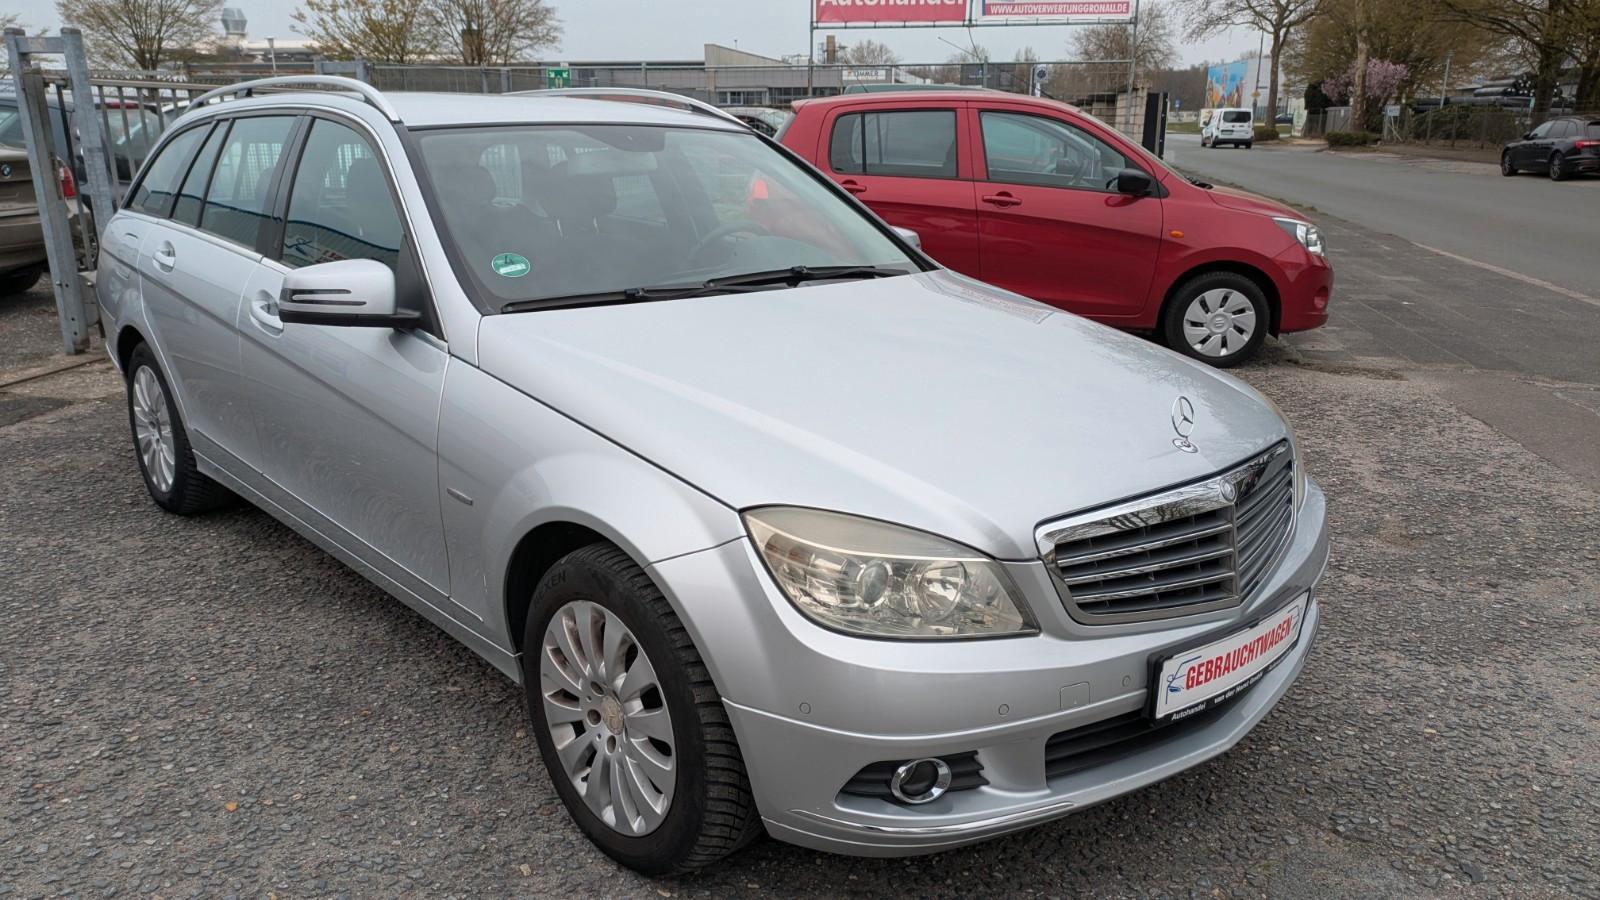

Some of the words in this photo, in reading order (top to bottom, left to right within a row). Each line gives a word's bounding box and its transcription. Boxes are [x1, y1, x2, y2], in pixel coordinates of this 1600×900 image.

[990, 3, 1127, 14] WWW.AUTOVERWERTUNGGRONAU.DE
[1186, 616, 1292, 690] GEBRAUCHTWAGEN
[1172, 704, 1206, 721] Autohandel
[1225, 689, 1236, 698] der
